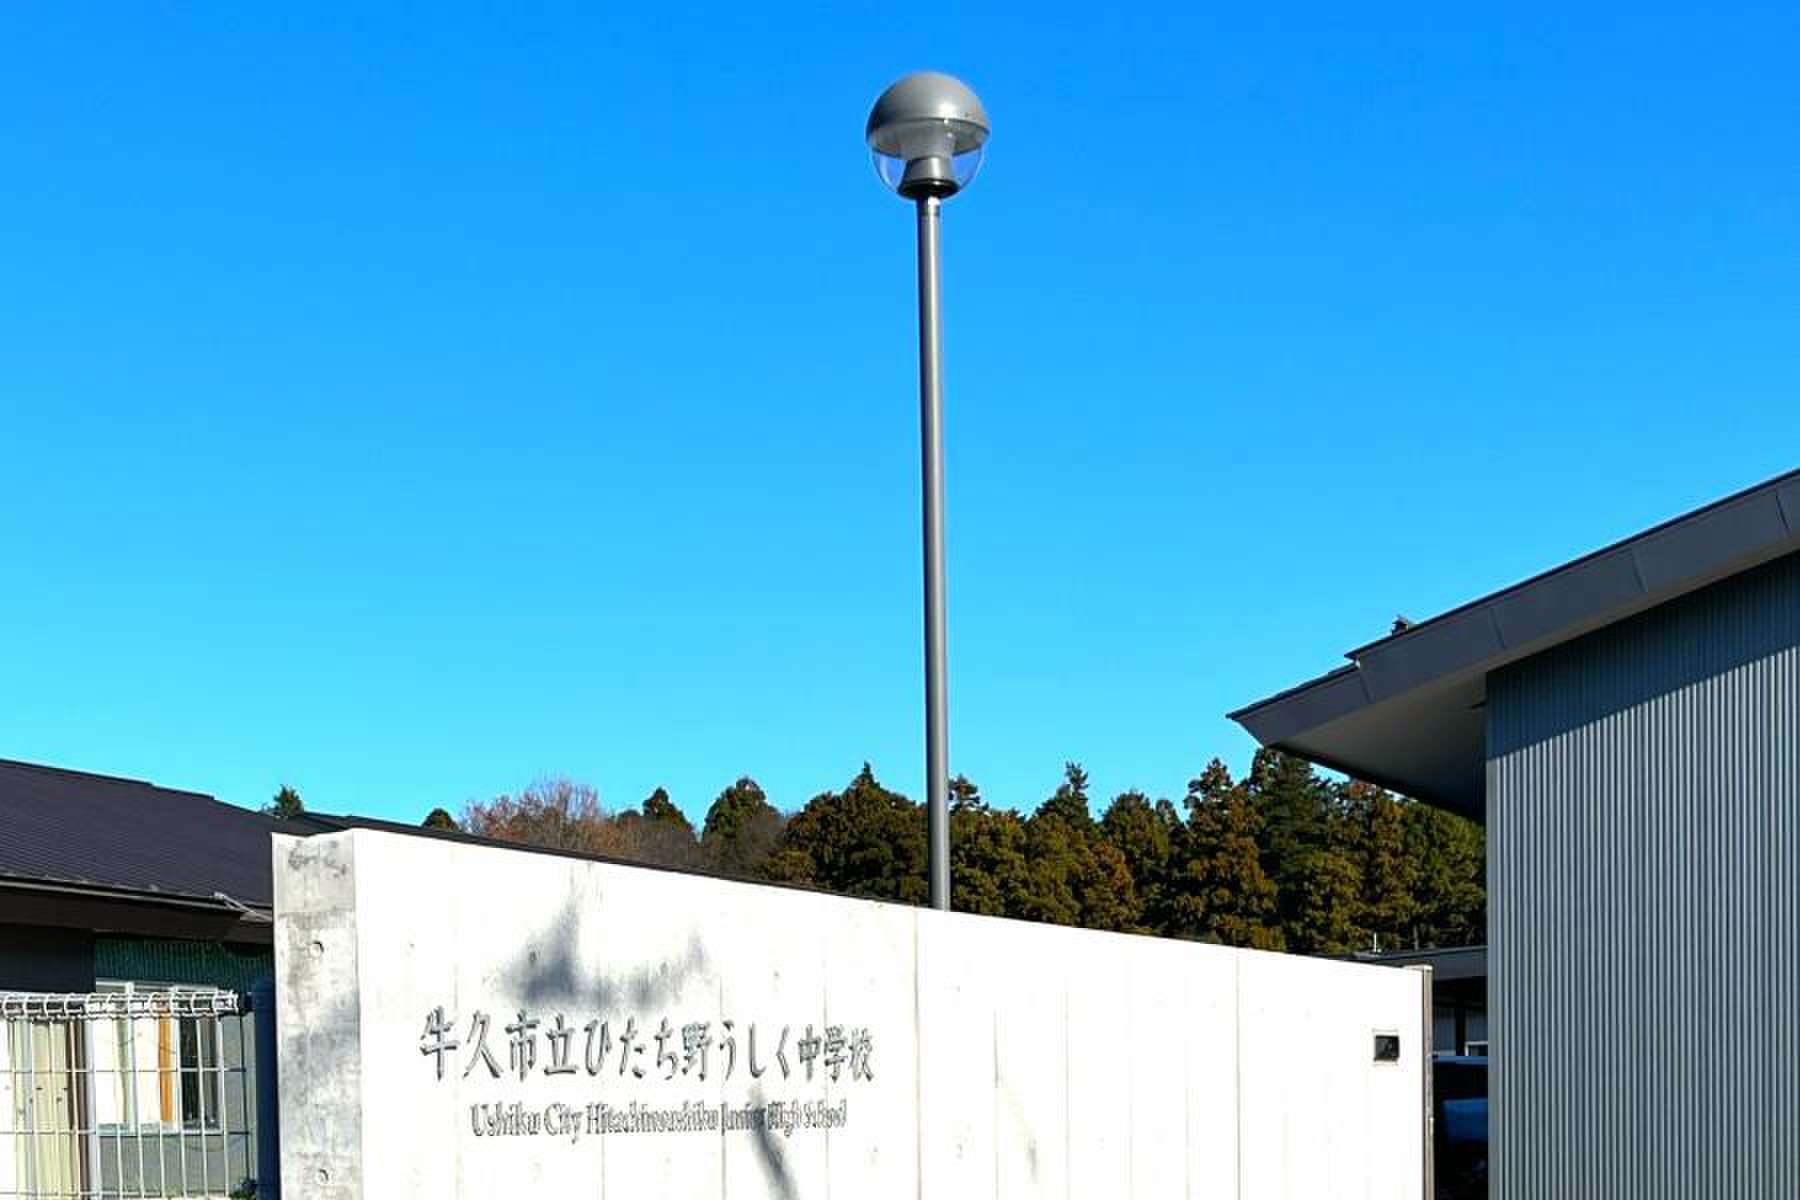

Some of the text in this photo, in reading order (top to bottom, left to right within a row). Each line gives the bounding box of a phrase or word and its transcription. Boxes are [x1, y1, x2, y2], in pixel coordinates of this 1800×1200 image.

[420, 1006, 874, 1082] 牛久市立ひたち野うしく中学校
[469, 1100, 541, 1137] Ushiku
[543, 1101, 583, 1145] City
[720, 1101, 766, 1136] Junior
[767, 1100, 801, 1138] High
[803, 1098, 848, 1130] School
